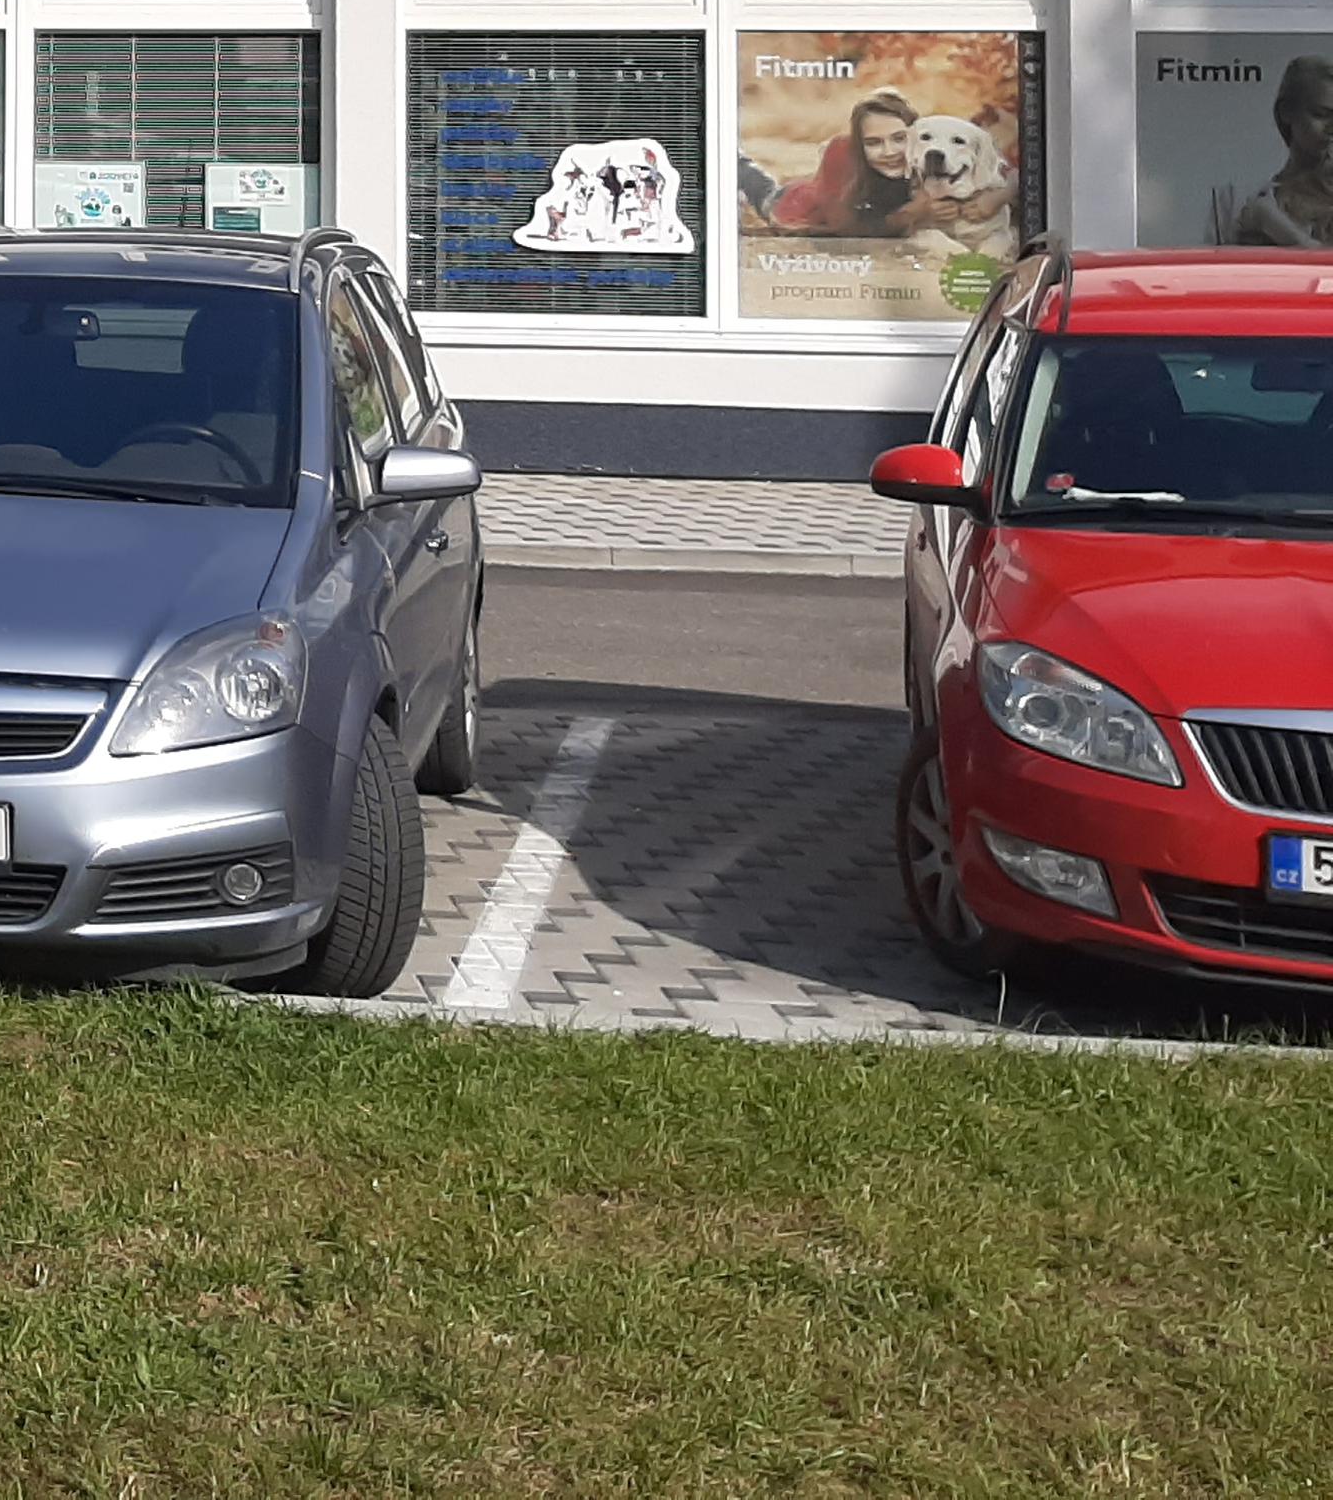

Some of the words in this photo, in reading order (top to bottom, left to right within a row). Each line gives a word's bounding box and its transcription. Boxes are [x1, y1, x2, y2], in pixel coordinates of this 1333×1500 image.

[754, 55, 856, 79] Fitmin
[1156, 56, 1262, 82] Fitmin
[771, 284, 853, 300] program
[860, 283, 922, 300] Fitmin
[1276, 868, 1300, 884] CZ
